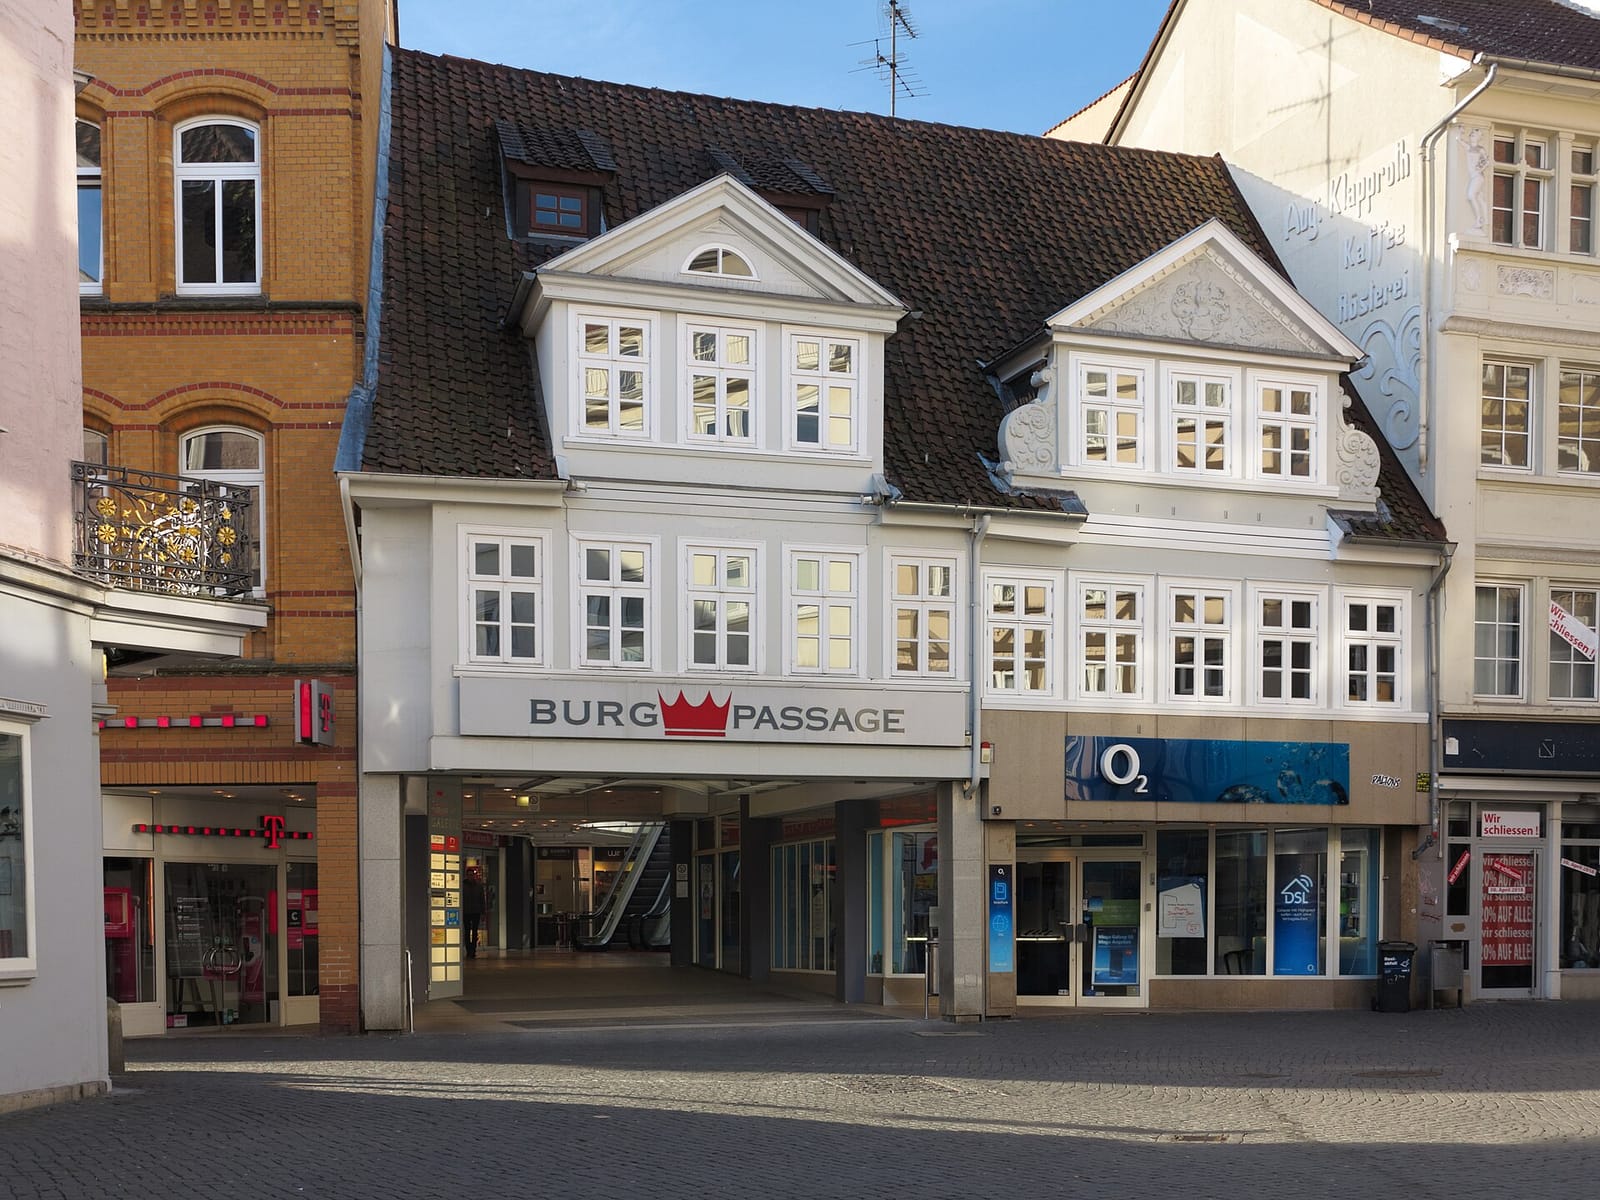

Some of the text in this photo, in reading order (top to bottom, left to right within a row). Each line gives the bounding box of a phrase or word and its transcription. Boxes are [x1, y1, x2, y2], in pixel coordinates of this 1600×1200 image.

[1342, 219, 1406, 271] Kaffee
[1551, 603, 1566, 621] Wir
[529, 698, 906, 734] BURG PASSAGE
[1484, 814, 1501, 823] Wir
[263, 815, 286, 849] T
[1484, 825, 1533, 836] schliessen
[1284, 891, 1309, 904] DSL
[1497, 906, 1513, 922] AUF
[1497, 943, 1513, 960] AUF
